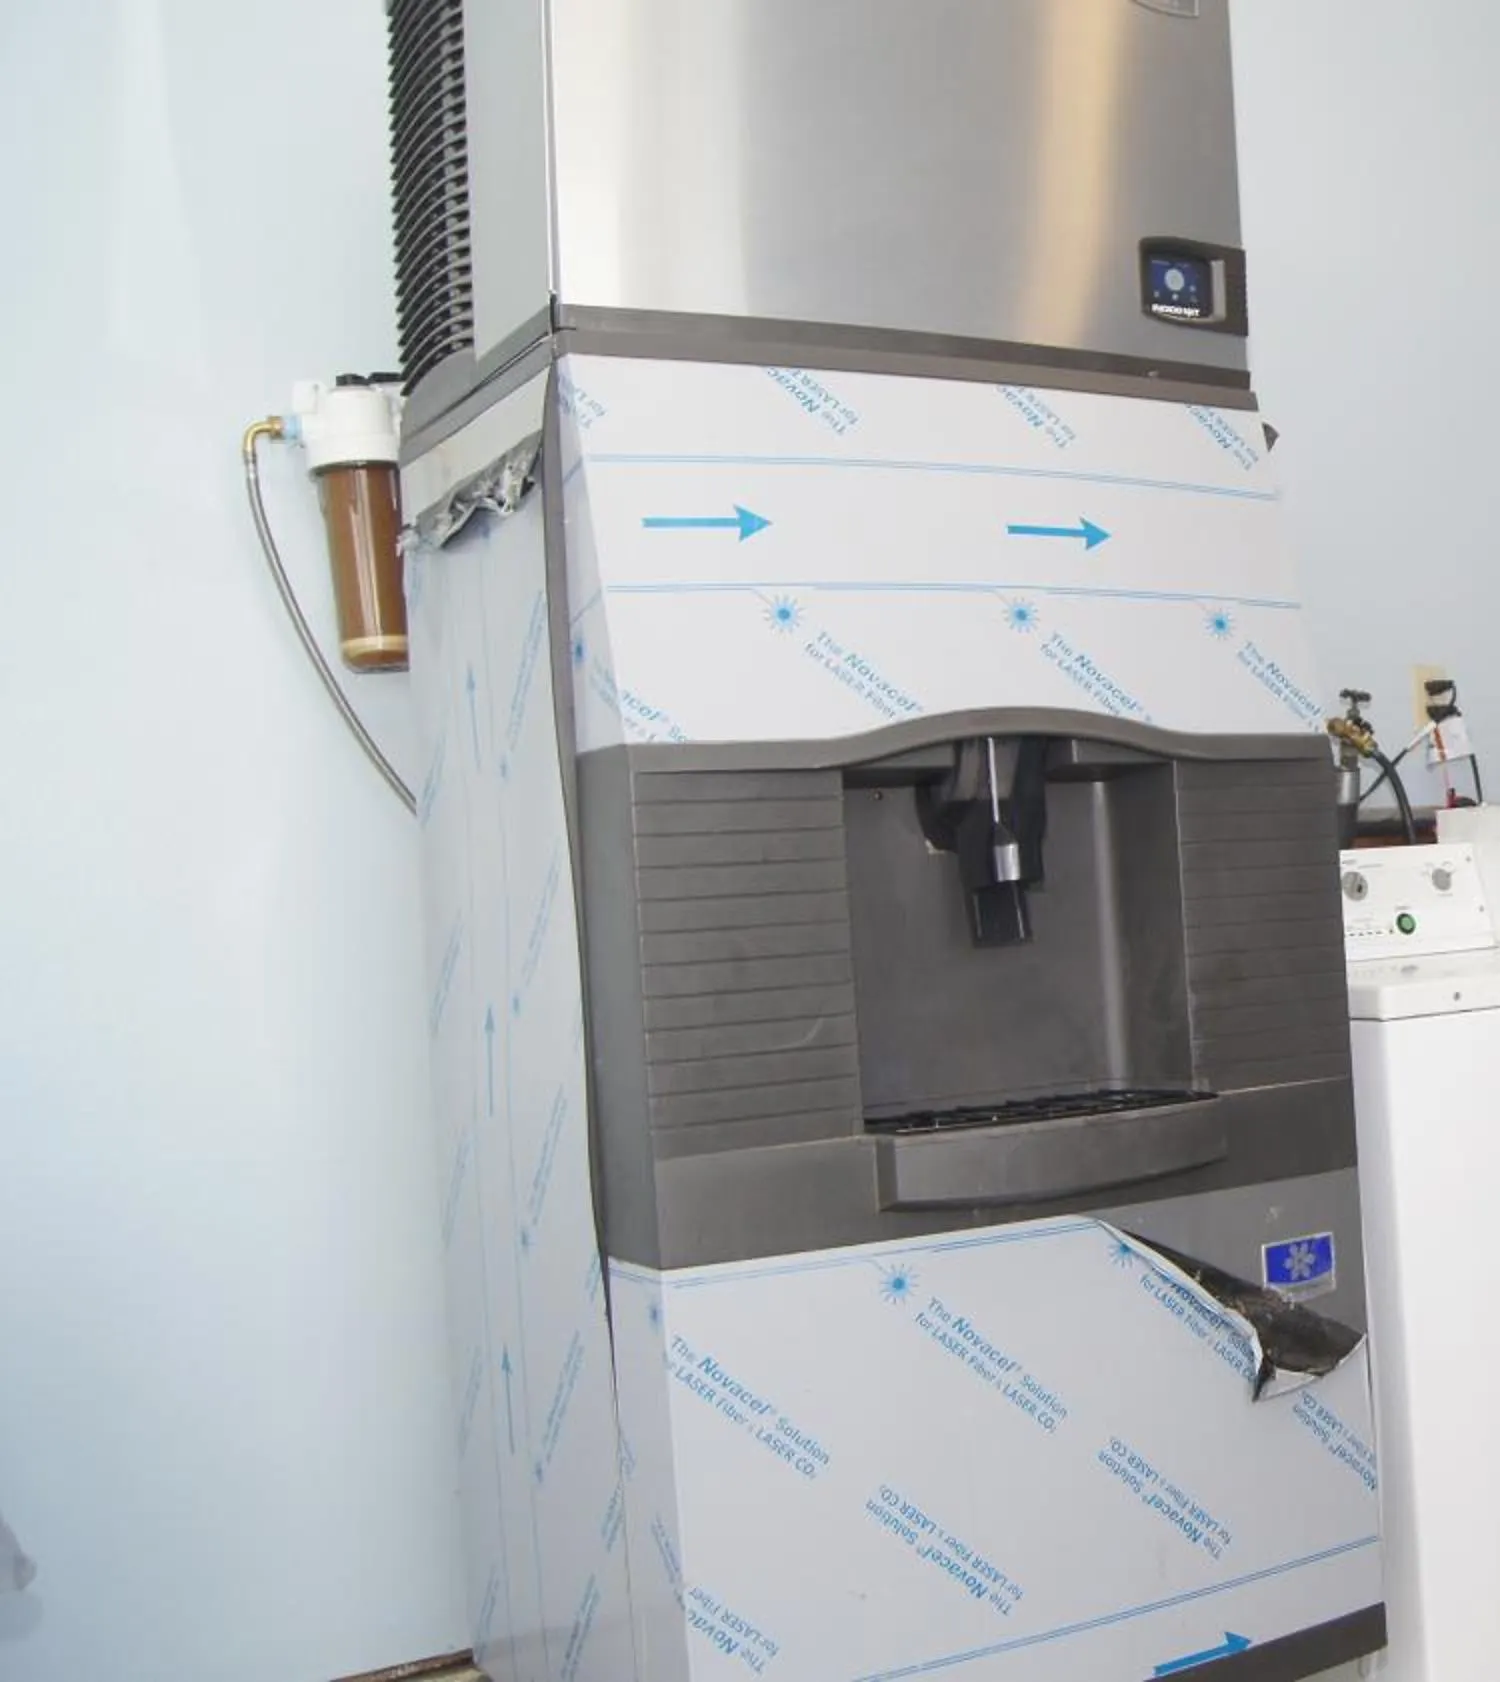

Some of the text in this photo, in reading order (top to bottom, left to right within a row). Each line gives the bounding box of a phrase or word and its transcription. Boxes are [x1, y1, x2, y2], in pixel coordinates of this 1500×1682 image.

[915, 1312, 933, 1330] for
[932, 1325, 969, 1360] LASER
[1002, 1383, 1037, 1419] LASER
[928, 1296, 951, 1323] The
[1020, 1374, 1069, 1419] Solution
[670, 1336, 697, 1362] The
[775, 1416, 831, 1465] Solution
[674, 1365, 717, 1403] LASER
[755, 1426, 795, 1464] LASER
[1098, 1449, 1142, 1493] Solution
[1128, 1453, 1159, 1484] LASER
[865, 1499, 918, 1545] Solution
[899, 1501, 937, 1534] LASER
[971, 1555, 1007, 1587] LASER
[721, 1609, 762, 1644] LASER
